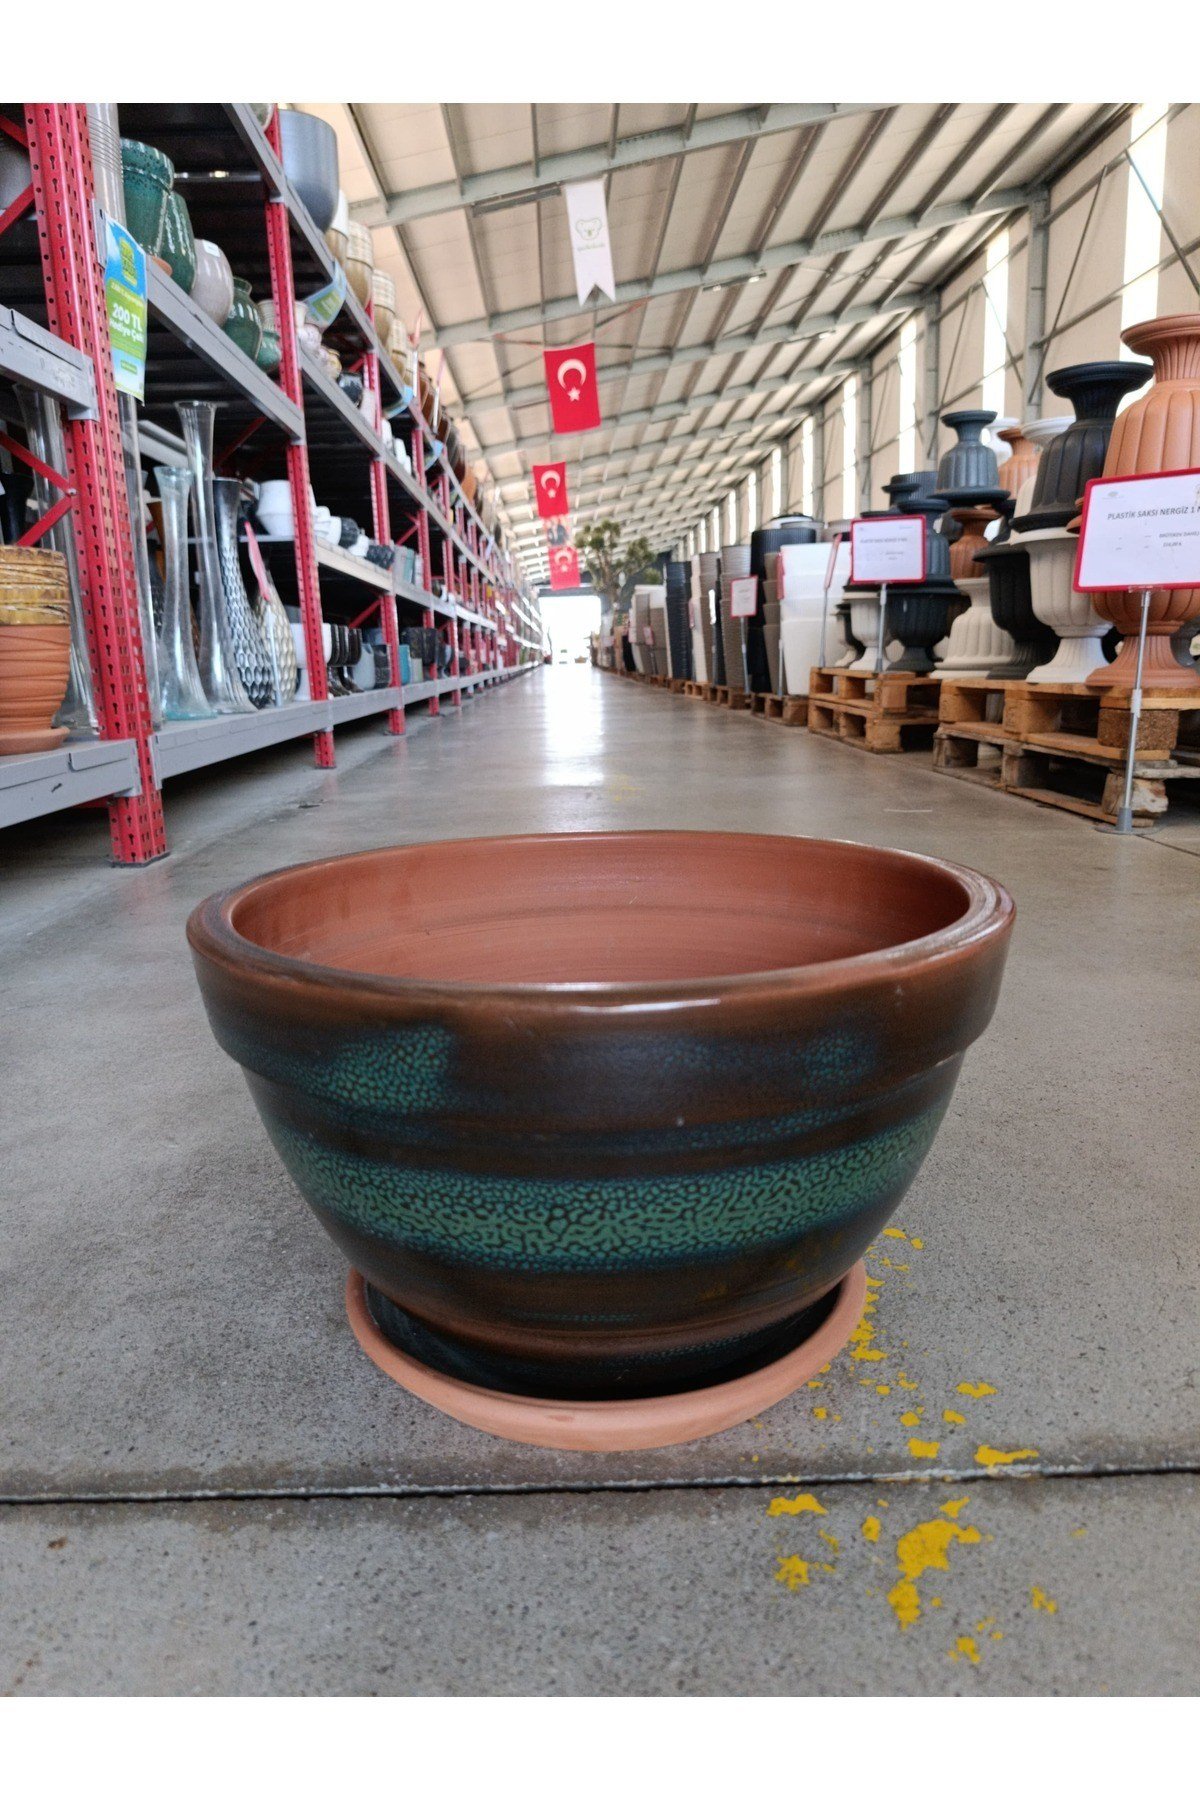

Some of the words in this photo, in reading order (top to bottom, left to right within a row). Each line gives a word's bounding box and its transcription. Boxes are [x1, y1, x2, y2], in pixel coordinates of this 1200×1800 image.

[112, 302, 131, 325] 200
[131, 313, 143, 332] TL
[1107, 511, 1136, 520] PLASTİK
[1137, 509, 1159, 518] SAKSI
[1159, 506, 1189, 516] NERGİZ
[1190, 506, 1195, 514] 1
